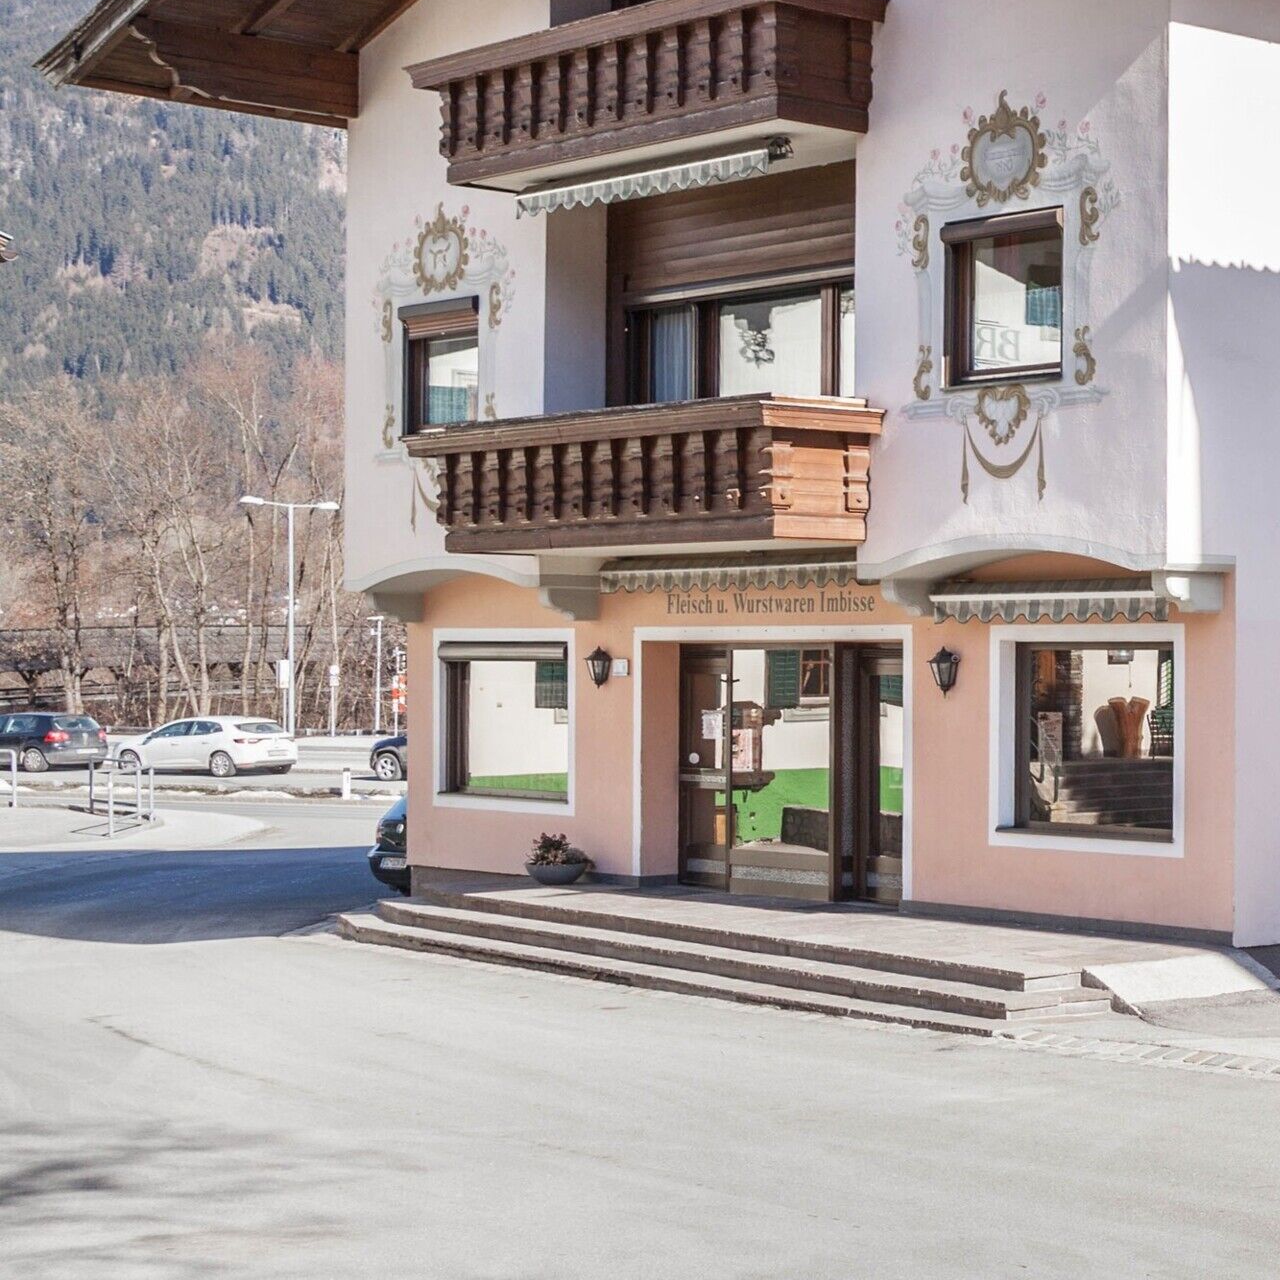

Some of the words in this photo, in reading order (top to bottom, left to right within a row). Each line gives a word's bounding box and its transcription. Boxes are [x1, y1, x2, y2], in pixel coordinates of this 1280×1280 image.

[667, 593, 713, 615] Fleisch
[717, 598, 728, 614] u.
[733, 592, 815, 613] Wurstwaren
[820, 591, 875, 612] Imbisse
